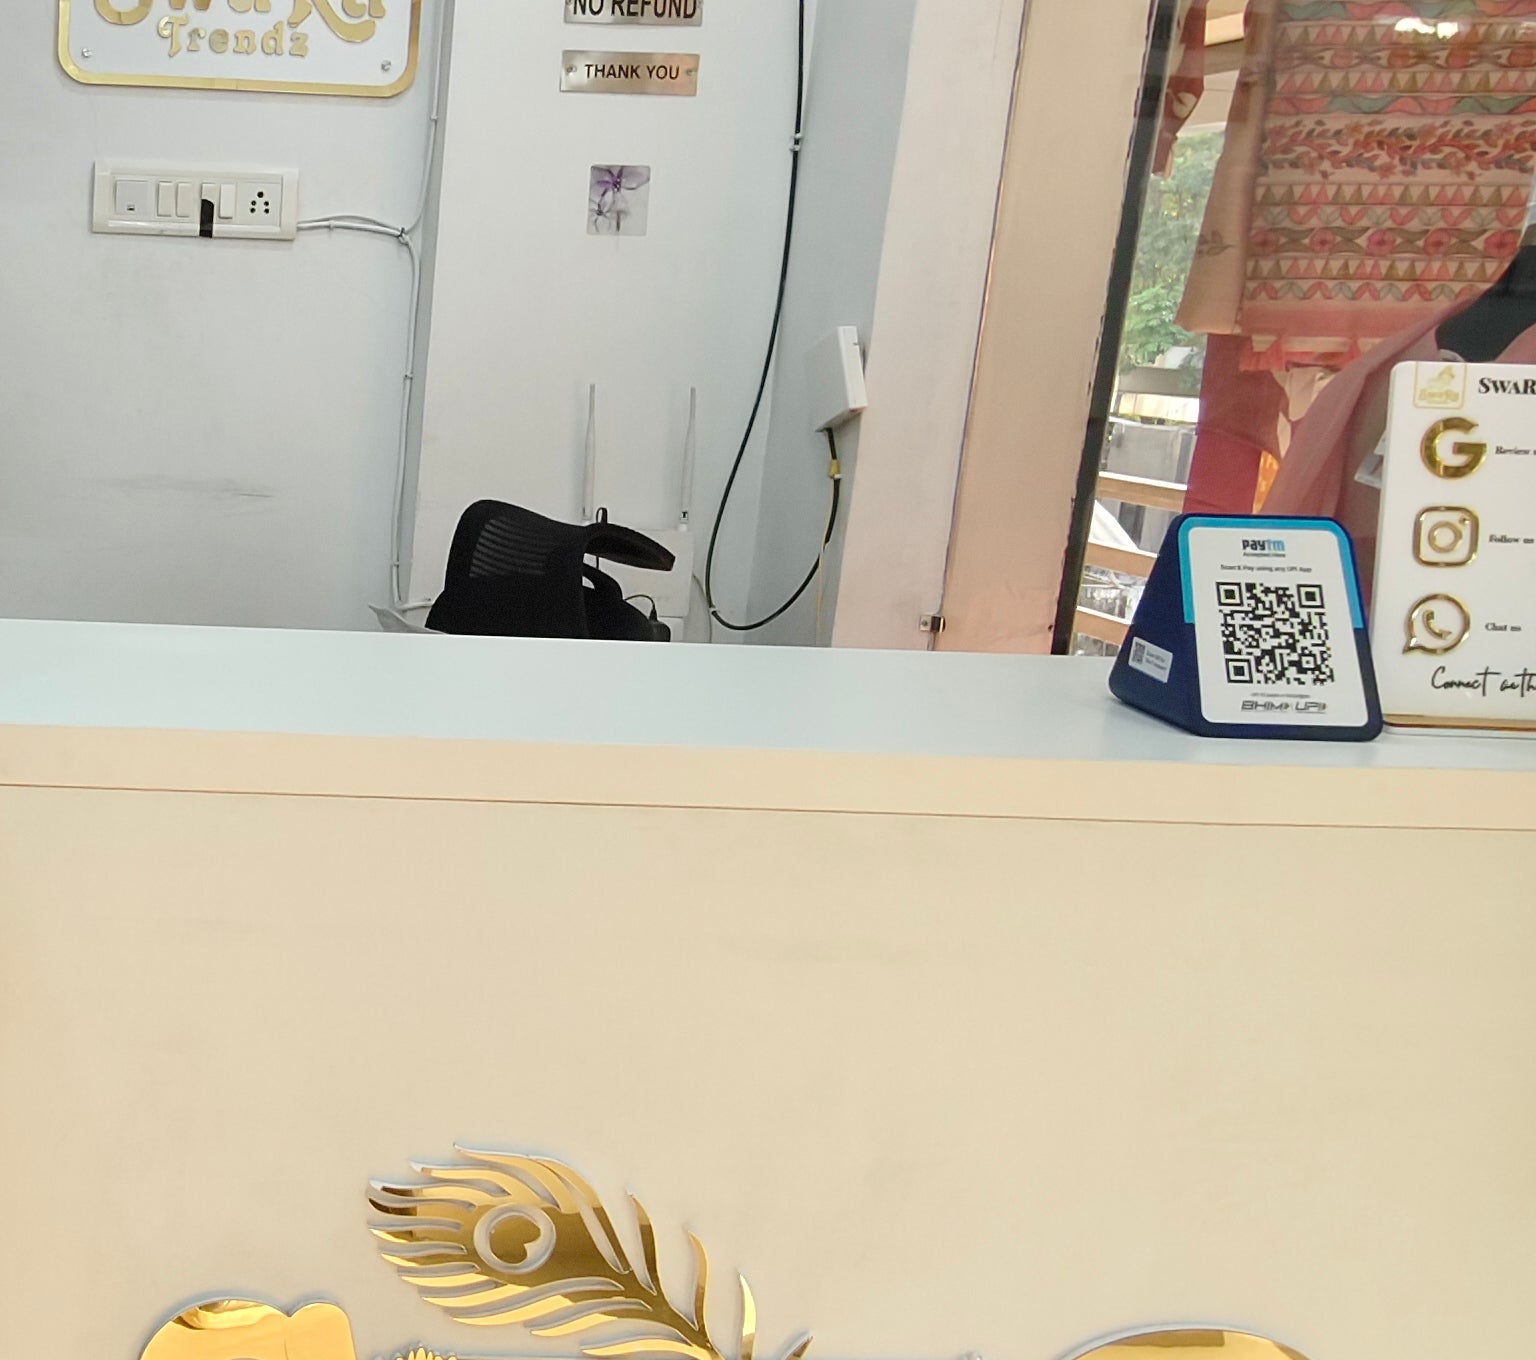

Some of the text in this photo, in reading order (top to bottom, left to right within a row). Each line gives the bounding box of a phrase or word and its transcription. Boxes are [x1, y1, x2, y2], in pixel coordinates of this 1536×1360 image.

[157, 13, 310, 58] Trendz
[584, 64, 681, 80] THANK YOU
[1489, 533, 1520, 544] Follow
[1484, 621, 1508, 632] Chat
[1431, 665, 1502, 697] Connect
[1241, 700, 1284, 711] BHIM
